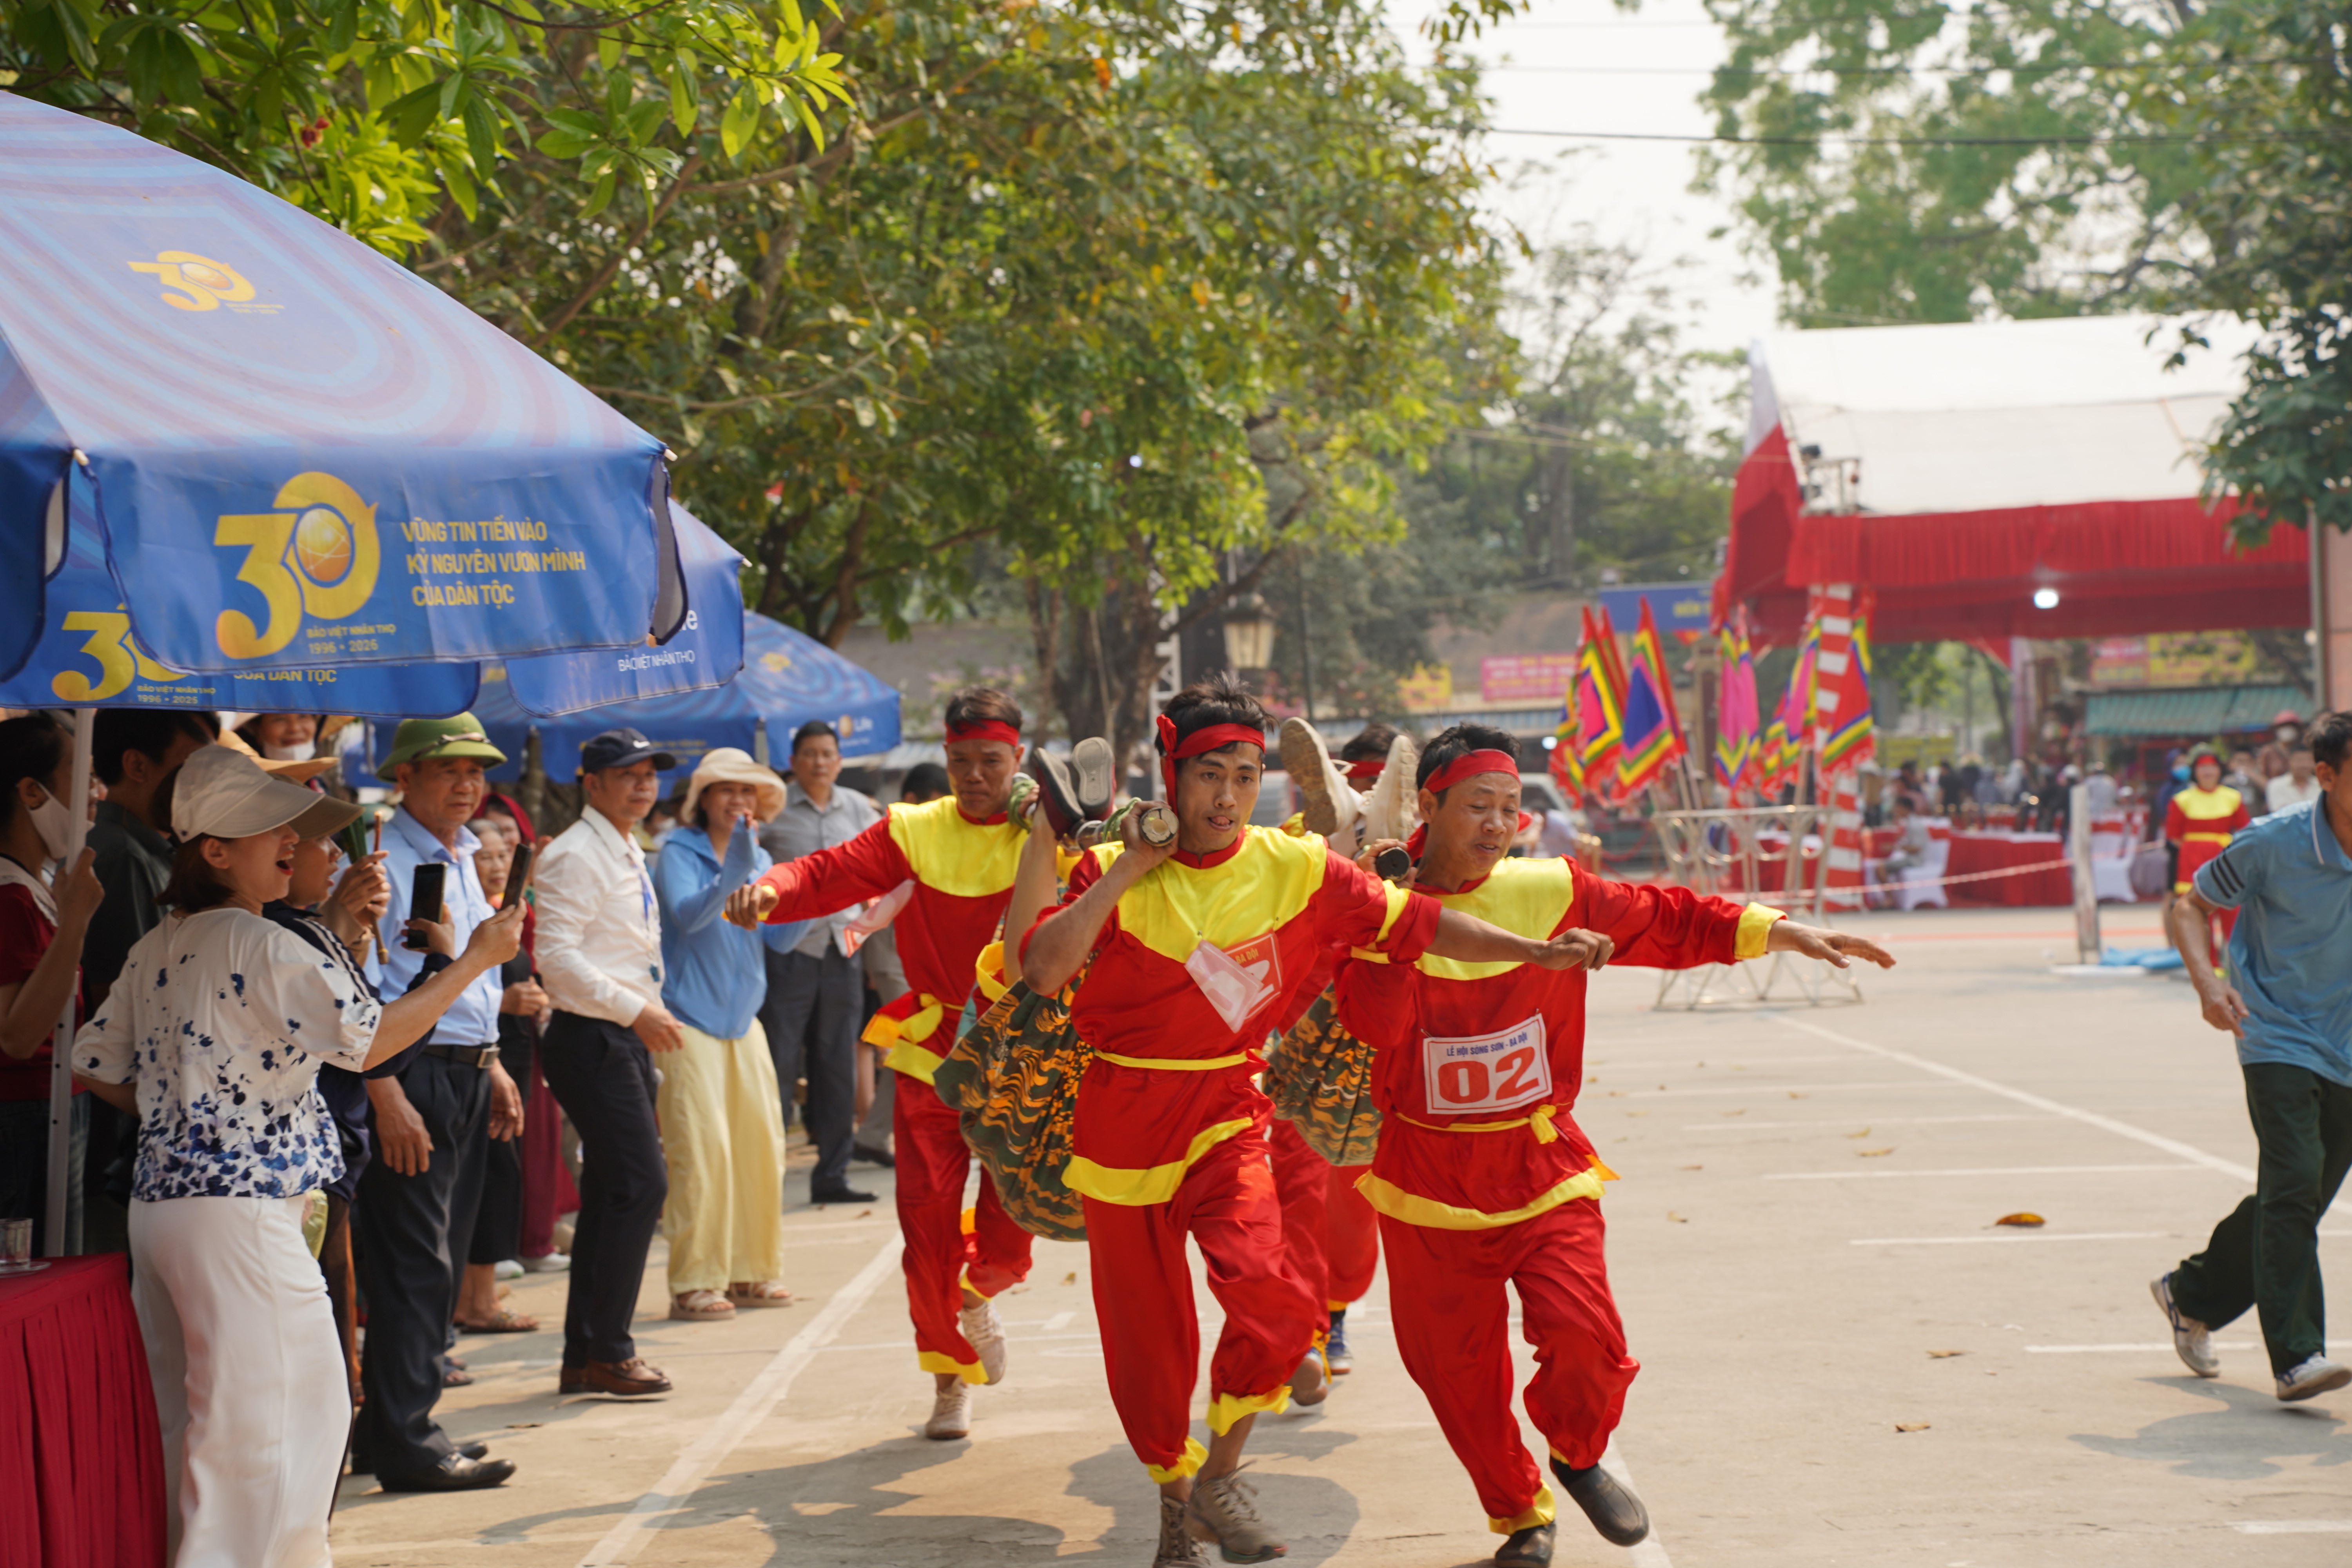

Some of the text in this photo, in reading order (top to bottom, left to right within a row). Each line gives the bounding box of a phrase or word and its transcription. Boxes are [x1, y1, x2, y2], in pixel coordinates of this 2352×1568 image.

[447, 521, 477, 541] TIN
[477, 514, 516, 541] TIẾN
[515, 516, 547, 541] VÀO
[213, 471, 381, 659] 30
[406, 547, 429, 574] KỶ
[432, 548, 497, 574] NGUYÊN
[541, 547, 586, 572] MÌNH
[412, 579, 515, 610] CỦA DÂN TỘC
[309, 641, 336, 655] 1996
[348, 639, 379, 652] 2026
[651, 650, 676, 667] NHÂN
[675, 650, 696, 664] THỌ
[1456, 1046, 1468, 1057] HỘI
[1510, 1038, 1517, 1047] BA
[1438, 1046, 1539, 1104] 02
